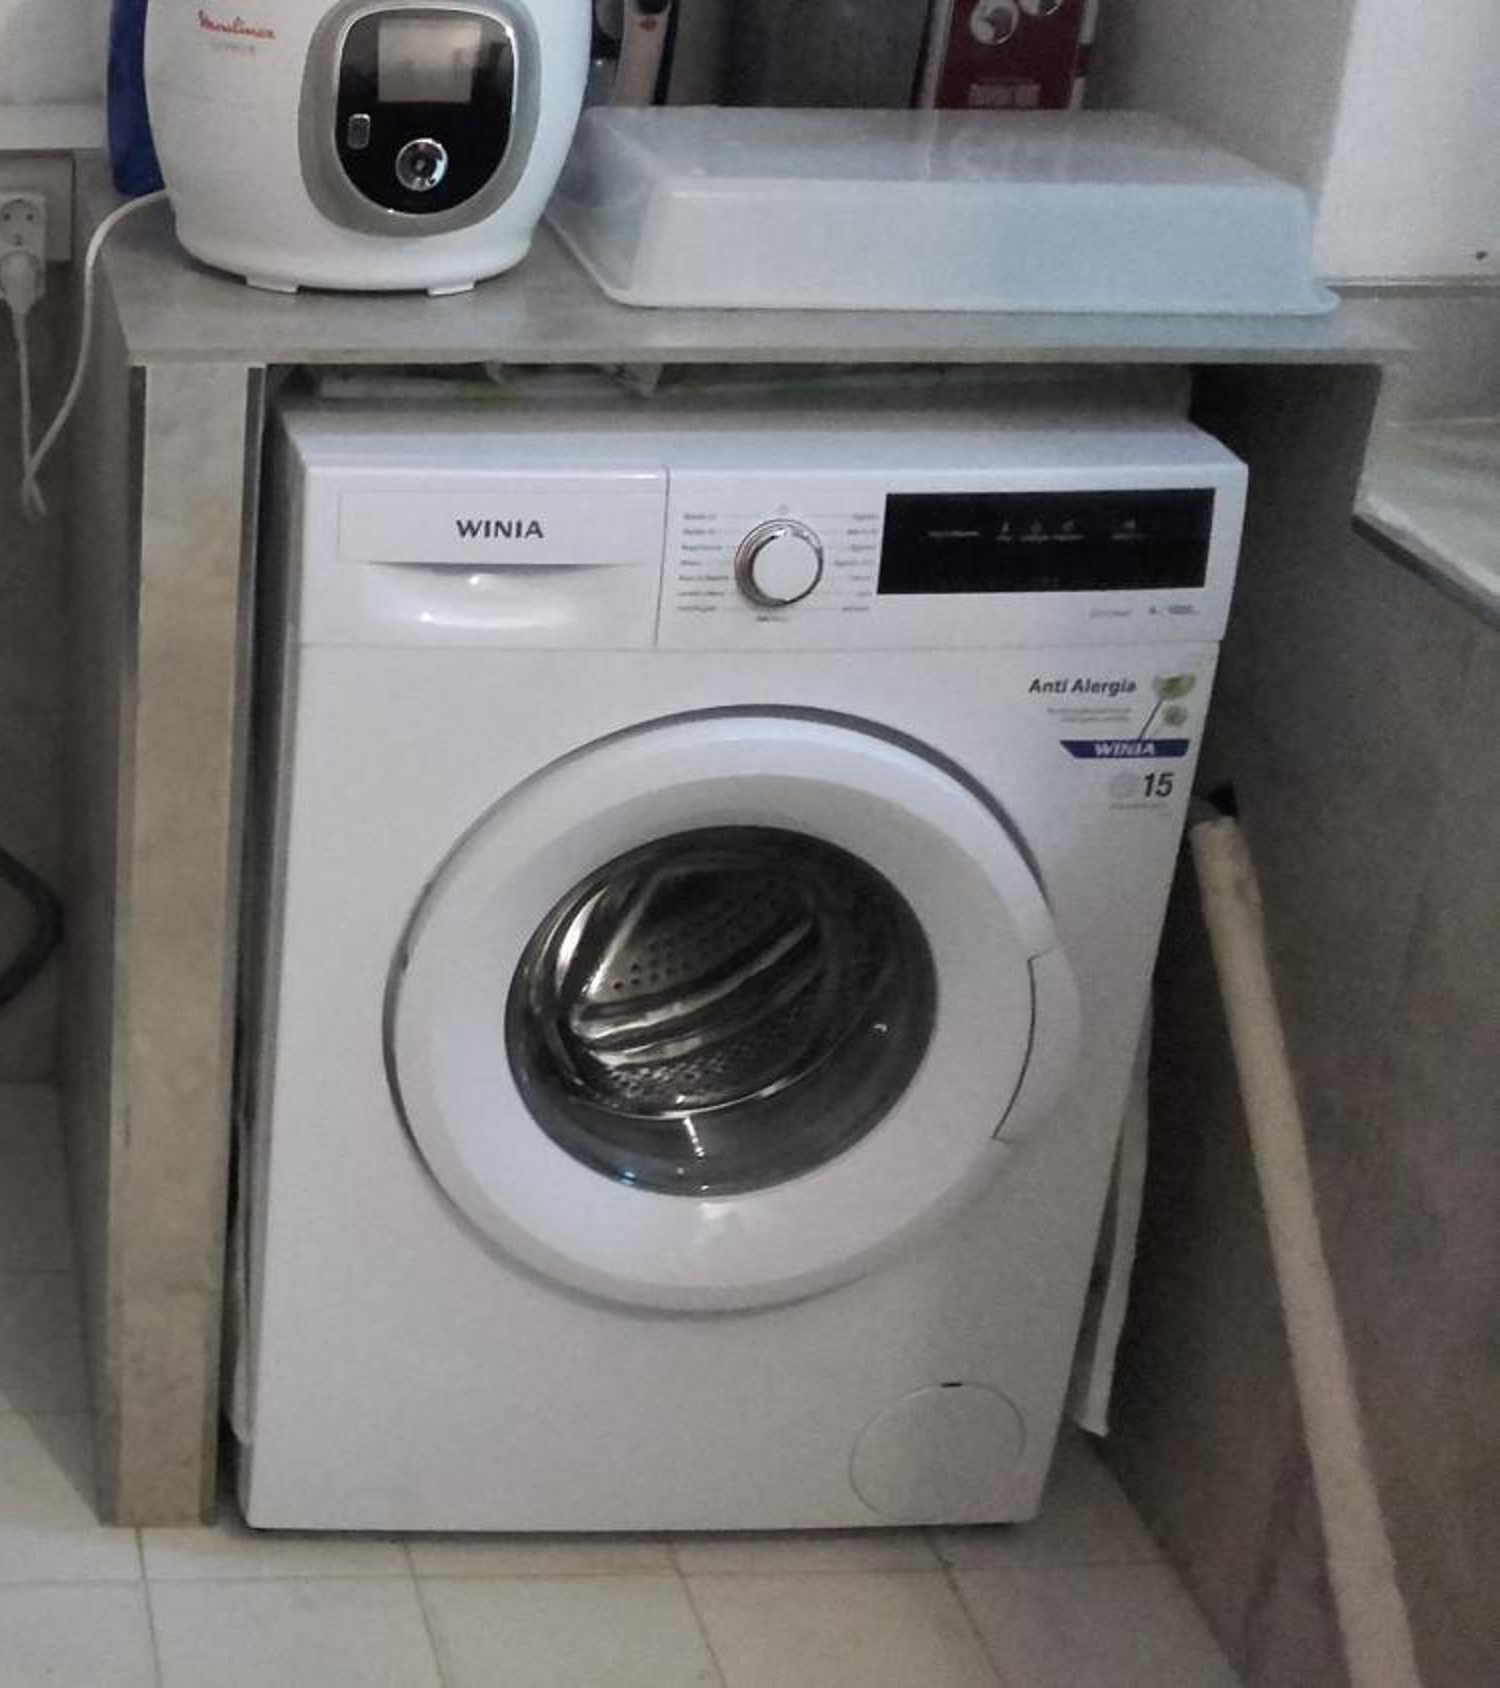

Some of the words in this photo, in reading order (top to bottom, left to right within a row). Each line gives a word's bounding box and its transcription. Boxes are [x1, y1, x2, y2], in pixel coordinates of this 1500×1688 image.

[455, 519, 544, 539] WINIA
[1028, 678, 1069, 694] Anti
[1071, 678, 1137, 697] Alergia
[1094, 742, 1157, 757] WINIA
[1144, 772, 1175, 798] 15
